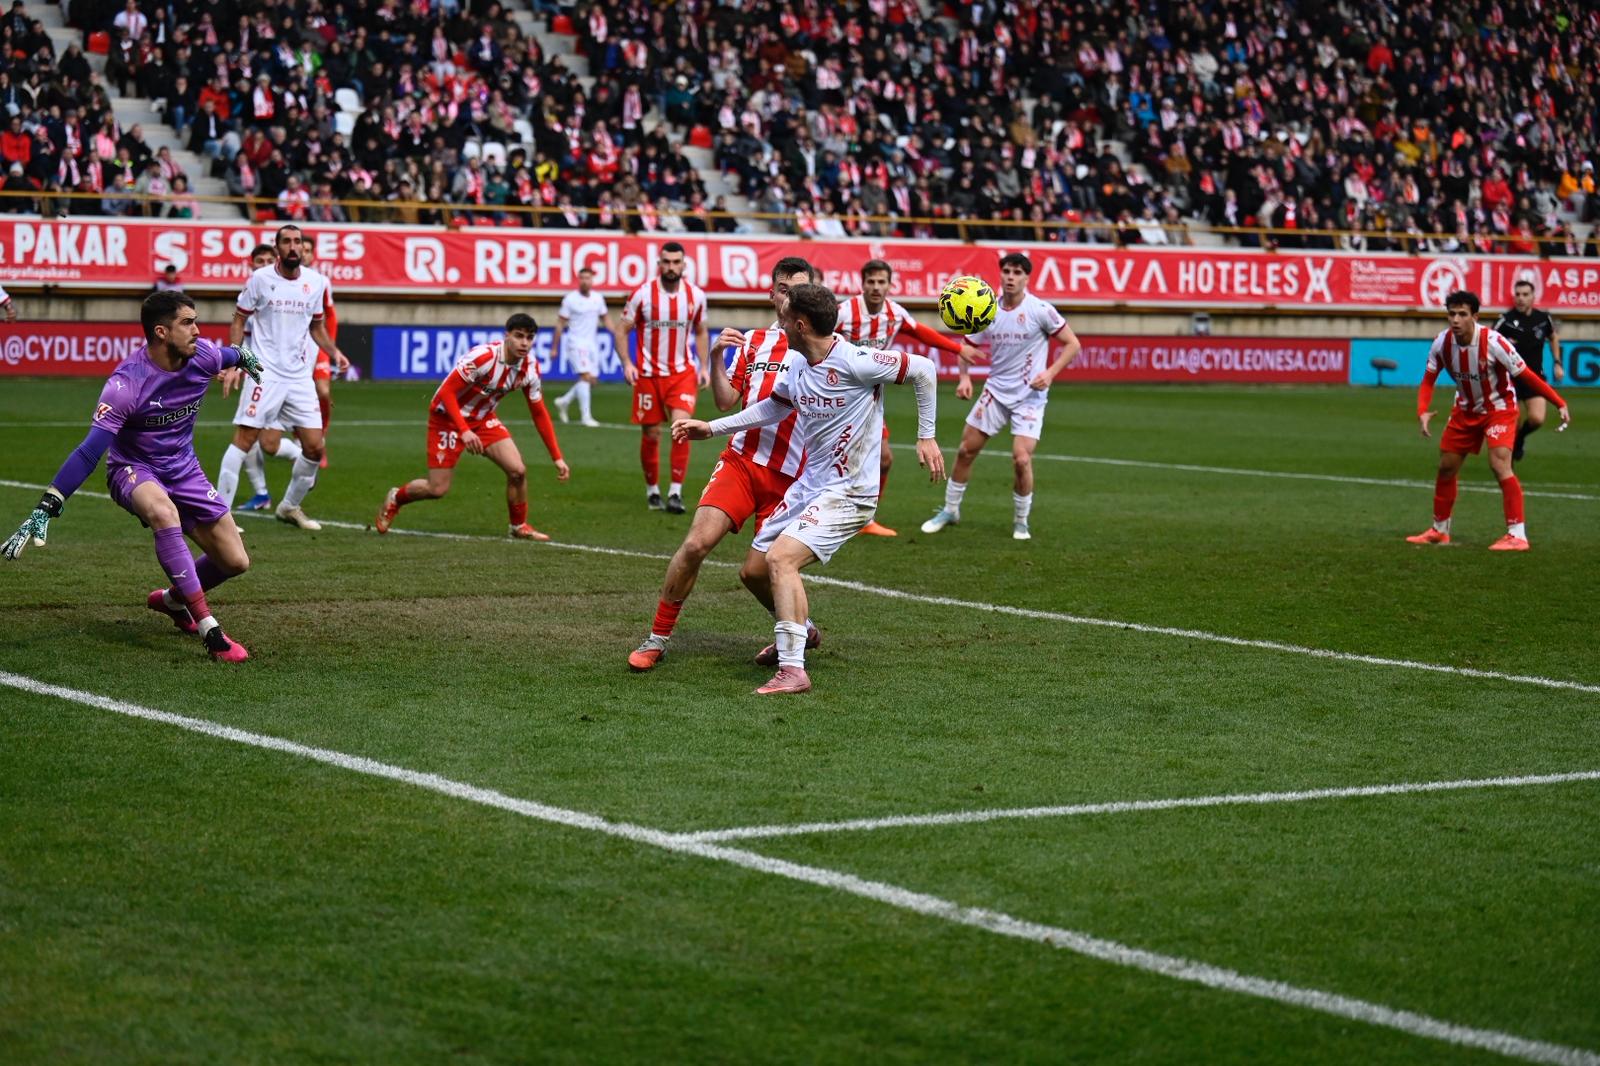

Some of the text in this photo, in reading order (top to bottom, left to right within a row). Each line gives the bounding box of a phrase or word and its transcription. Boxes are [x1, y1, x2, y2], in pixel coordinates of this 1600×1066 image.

[13, 222, 129, 267] PAKAR
[1035, 256, 1300, 296] ARVA HOTELES
[401, 330, 429, 374] 12
[1054, 346, 1127, 370] CNTACT
[1130, 347, 1149, 369] AT
[1151, 347, 1344, 374] CLIA@CYDLEONESA.COM
[251, 386, 263, 402] 6
[638, 393, 653, 410] 15
[437, 431, 459, 449] 36
